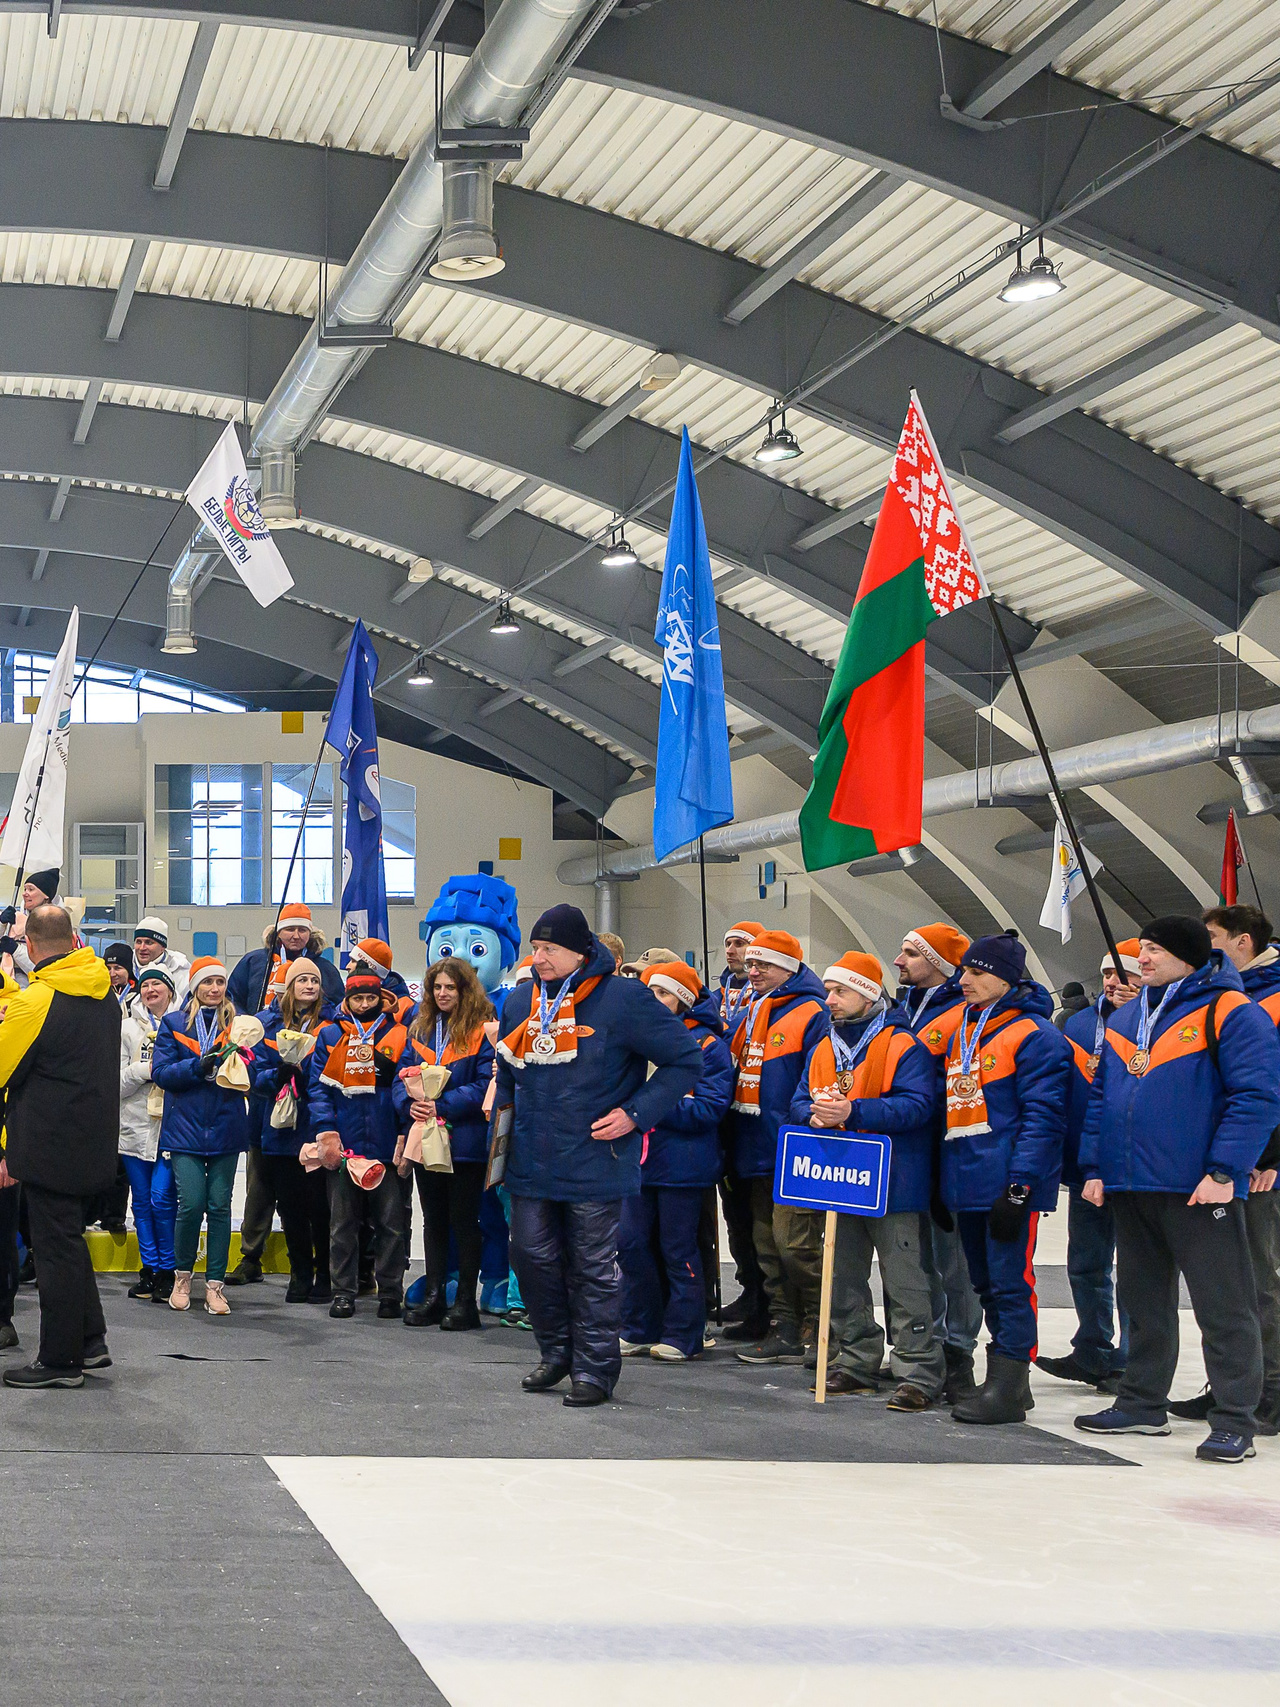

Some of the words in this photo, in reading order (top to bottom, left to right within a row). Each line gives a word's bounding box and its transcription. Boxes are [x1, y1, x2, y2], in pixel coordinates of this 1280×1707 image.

[203, 496, 231, 533] БЕЛЫЕ
[225, 528, 251, 563] ТИГРЫ
[913, 938, 941, 967] БЕЛАРУСЬ
[848, 975, 878, 995] БЕЛАРУСЬ
[792, 1155, 871, 1187] Молния
